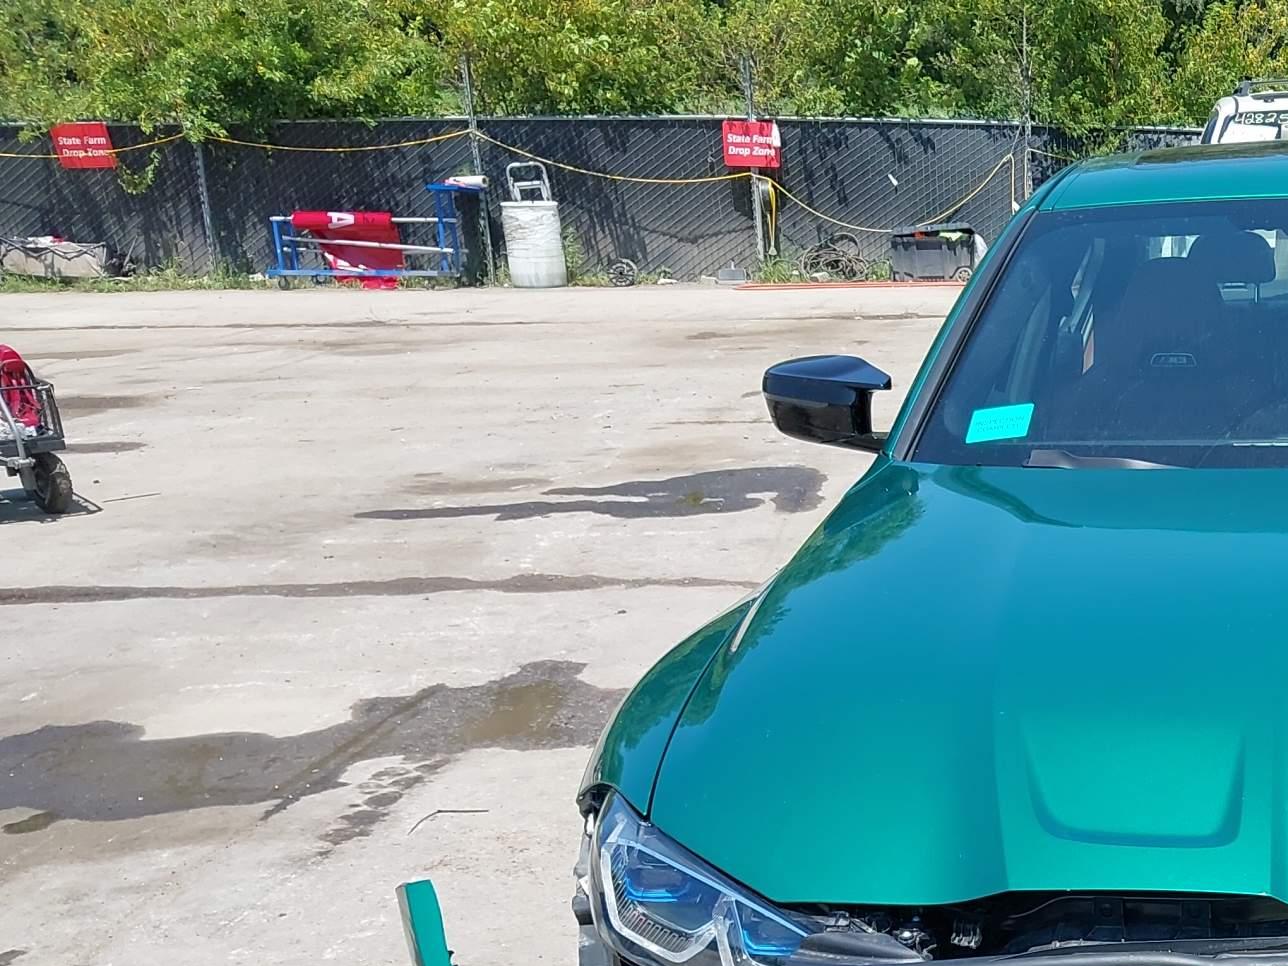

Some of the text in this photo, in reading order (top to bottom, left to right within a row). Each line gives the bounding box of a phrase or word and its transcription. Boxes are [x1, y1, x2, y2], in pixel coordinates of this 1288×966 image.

[57, 136, 107, 145] State Farm
[726, 133, 751, 143] State
[62, 148, 85, 158] Drop
[728, 146, 776, 157] Drop Zone
